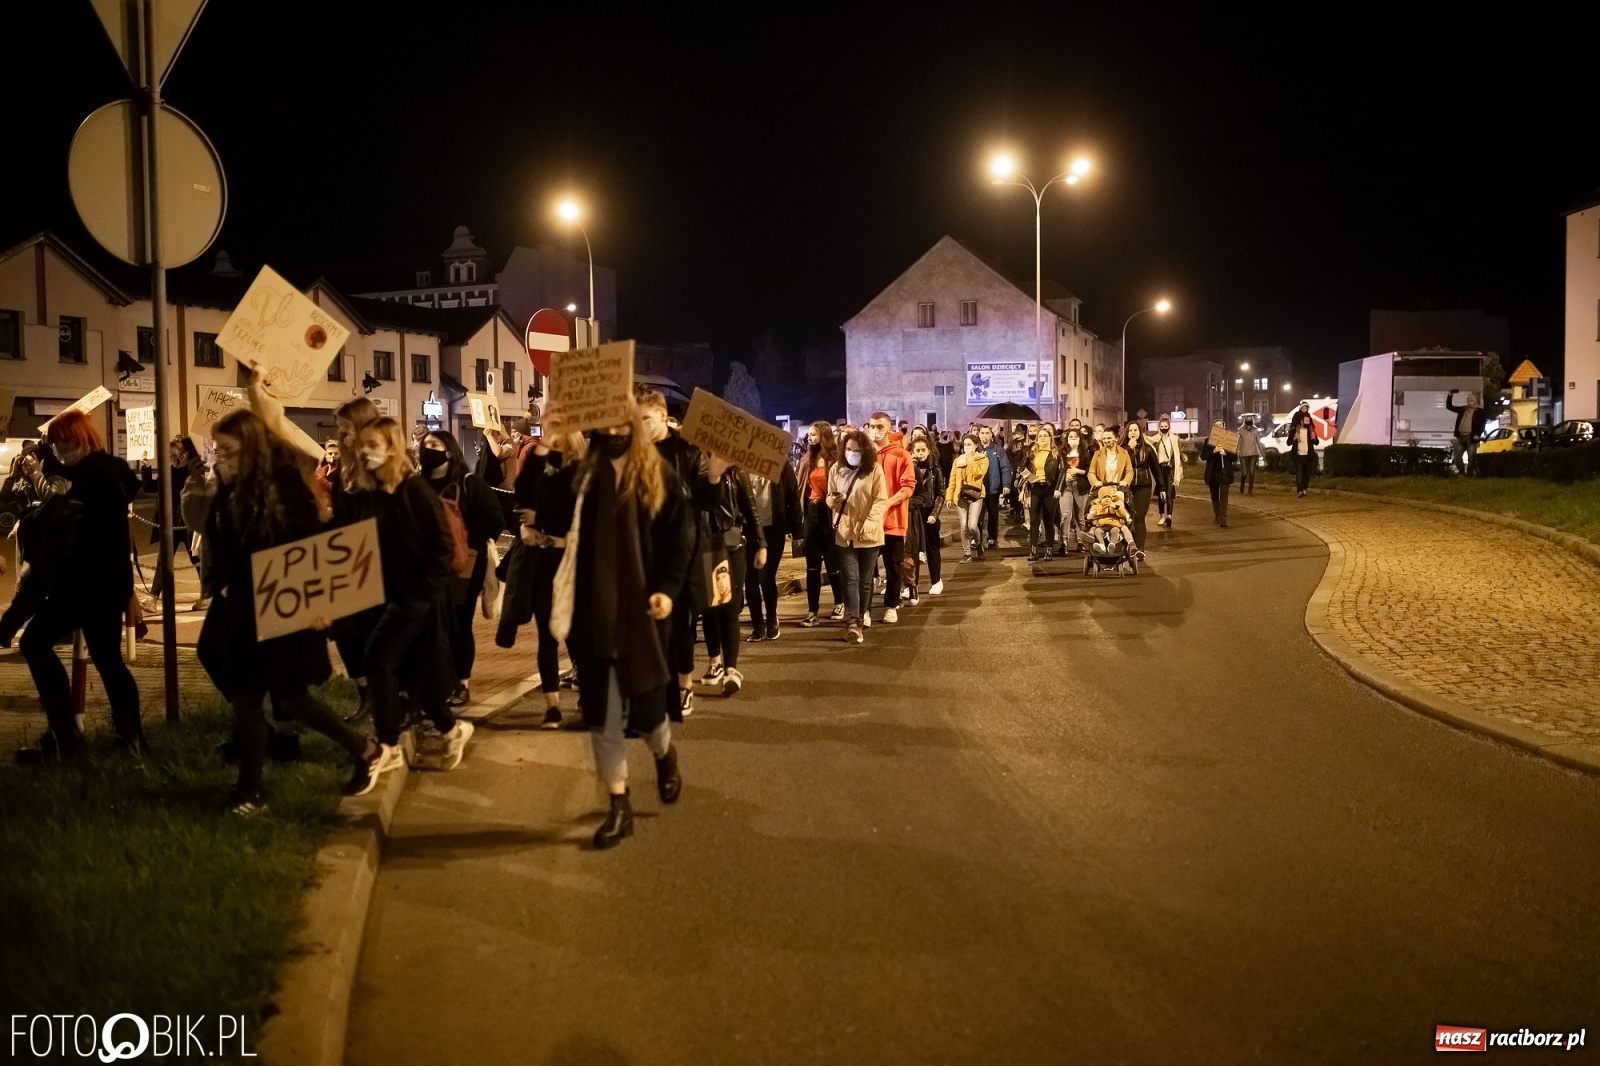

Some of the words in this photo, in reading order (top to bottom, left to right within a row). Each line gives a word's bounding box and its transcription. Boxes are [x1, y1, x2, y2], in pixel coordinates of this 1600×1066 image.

[207, 390, 235, 407] MARS
[719, 407, 750, 434] JAREK
[694, 427, 729, 456] PRAWA
[731, 446, 780, 476] KOBIET
[283, 531, 352, 578] PIS
[274, 574, 350, 619] OFF
